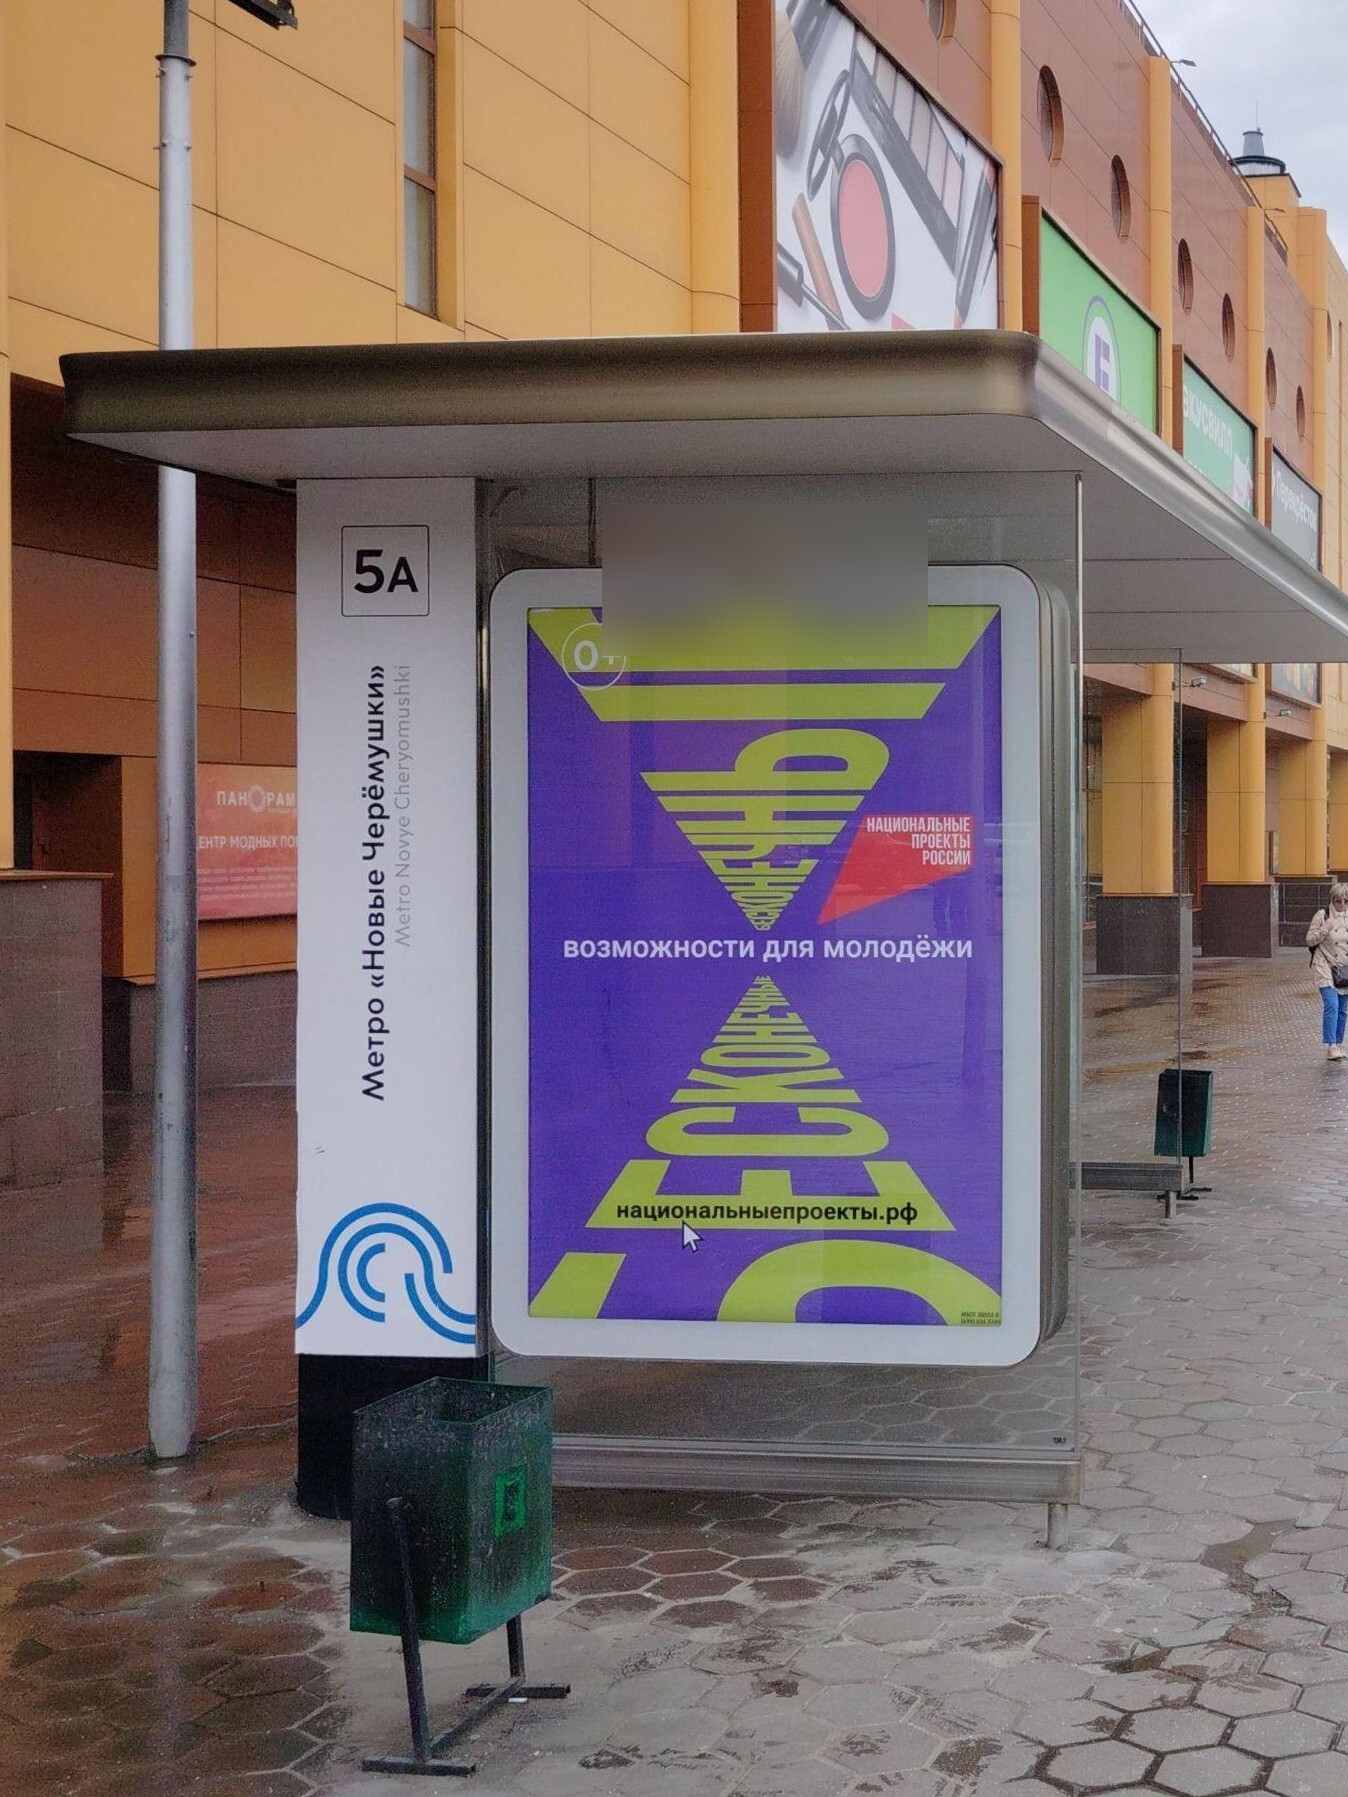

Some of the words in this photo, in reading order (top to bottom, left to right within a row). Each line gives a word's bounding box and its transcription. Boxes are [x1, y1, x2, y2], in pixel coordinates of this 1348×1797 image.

[394, 665, 414, 810] Cheryomushki
[361, 665, 391, 861] Черёмушки»
[216, 785, 296, 813] ПАНОРАМ
[866, 816, 971, 833] НАЦИОНАЛЬНЫЕ
[196, 836, 227, 850] ЕНТР
[230, 835, 278, 851] МОДНЫХ
[395, 815, 415, 878] Novye
[911, 833, 971, 849] ПРОЕКТЫ
[922, 850, 971, 866] РОССИИ
[361, 869, 386, 988] «Новые
[394, 884, 411, 947] Metro
[563, 938, 755, 959] возможности
[762, 939, 814, 963] для
[823, 934, 973, 963] молодёжи
[361, 998, 390, 1101] Метро
[616, 1202, 918, 1225] национальныепроекты.рф
